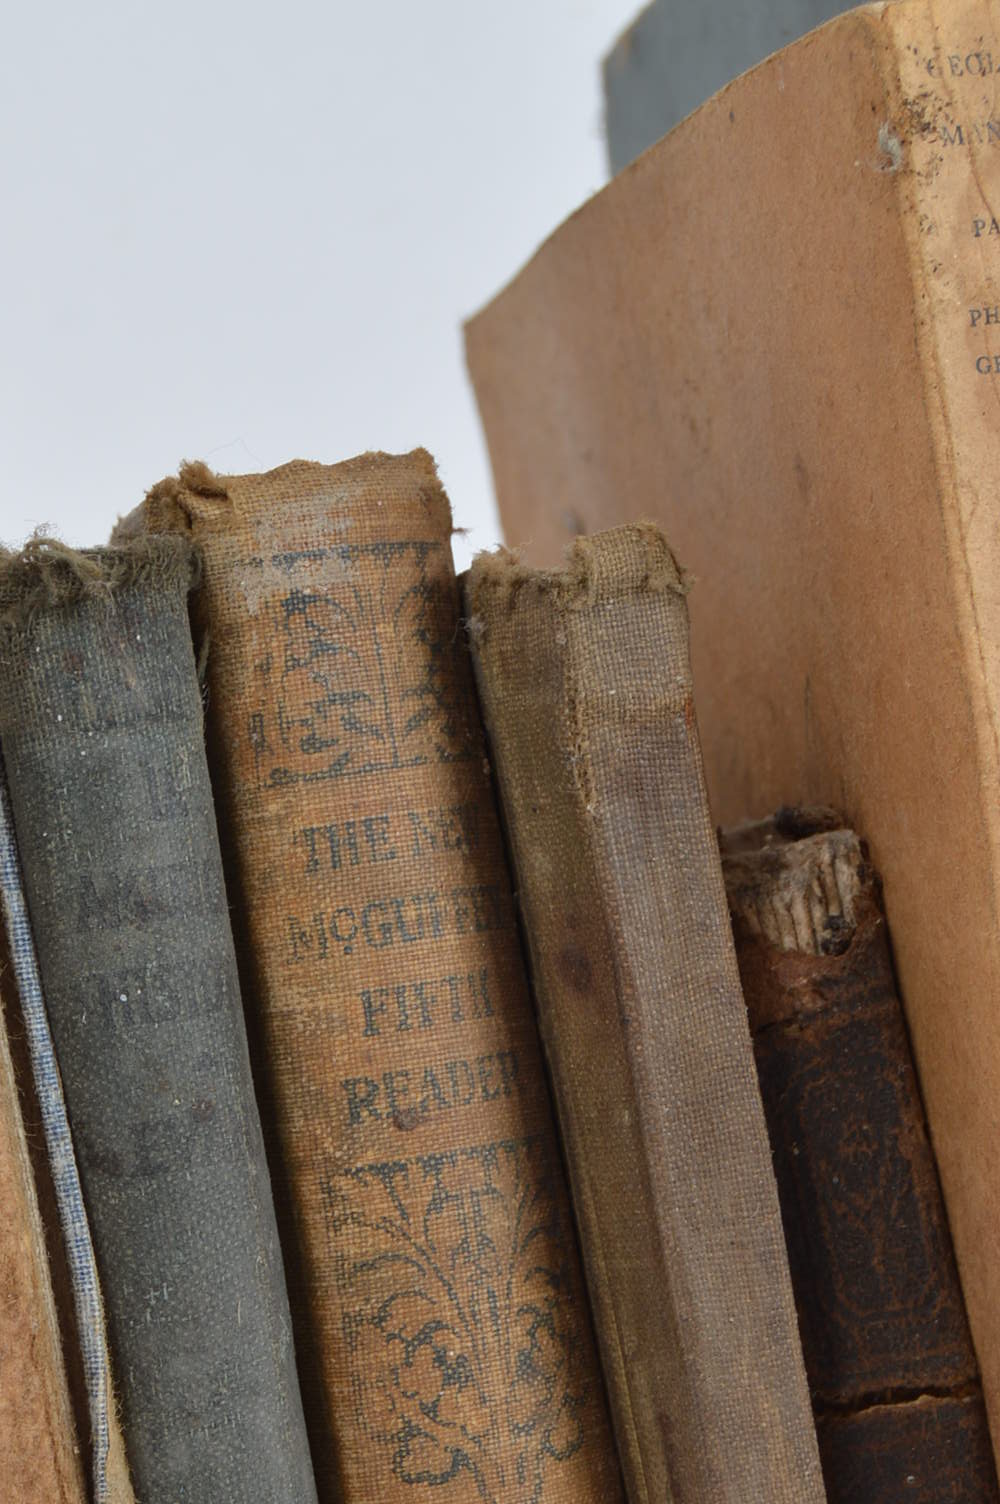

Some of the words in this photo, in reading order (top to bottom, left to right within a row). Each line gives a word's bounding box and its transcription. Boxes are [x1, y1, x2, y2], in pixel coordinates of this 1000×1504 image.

[294, 814, 396, 874] THE
[360, 967, 496, 1037] FIFTH
[341, 1050, 519, 1126] READER
